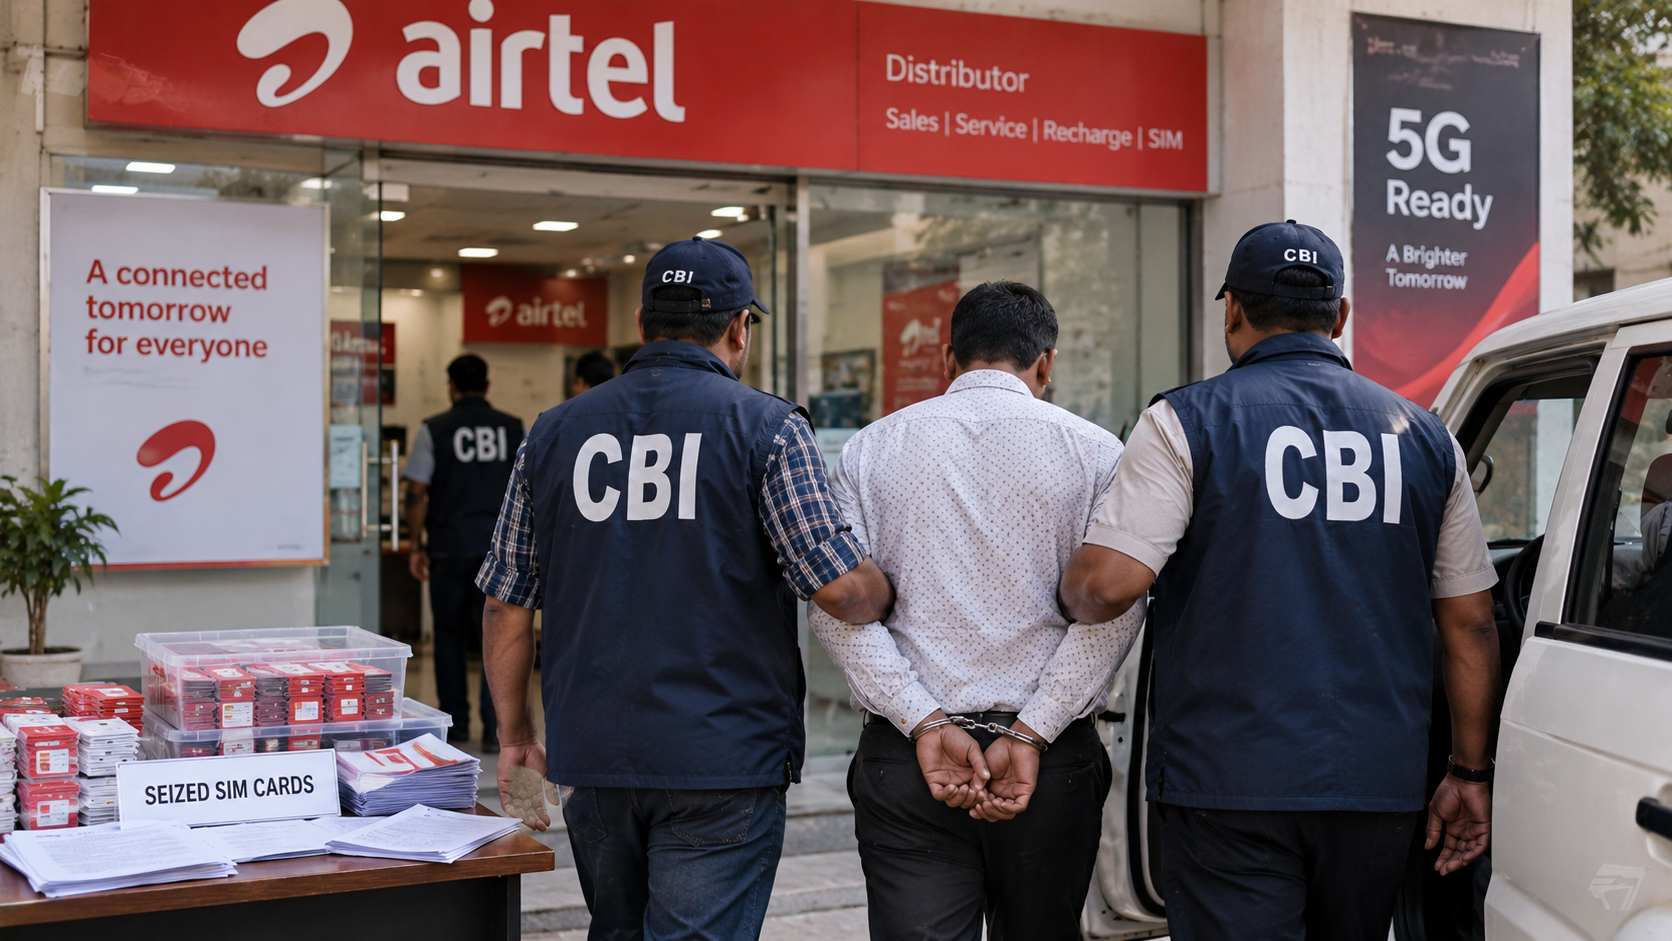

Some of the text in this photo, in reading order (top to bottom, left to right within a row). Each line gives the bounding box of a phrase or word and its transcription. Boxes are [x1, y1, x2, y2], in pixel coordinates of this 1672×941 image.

[396, 0, 686, 122] airtel
[886, 53, 1030, 93] Distributor
[886, 107, 939, 132] Sales
[955, 112, 1028, 139] Service
[1043, 119, 1133, 151] Recharge
[1148, 127, 1183, 151] SIM
[1385, 107, 1472, 174] 5G
[1386, 178, 1493, 230] Ready
[1283, 248, 1318, 264] CBI
[1385, 243, 1468, 270] A Brighter
[86, 259, 267, 290] A connected
[661, 269, 694, 284] CBI
[1385, 268, 1468, 290] Tomorrow
[86, 295, 232, 323] tomorrow
[515, 297, 588, 328] airtel
[85, 328, 268, 363] for everyone
[453, 426, 508, 463] CBI
[573, 433, 702, 522] CBI
[1265, 425, 1402, 524] CBI
[145, 775, 315, 806] SEIZED SIM CARDS
